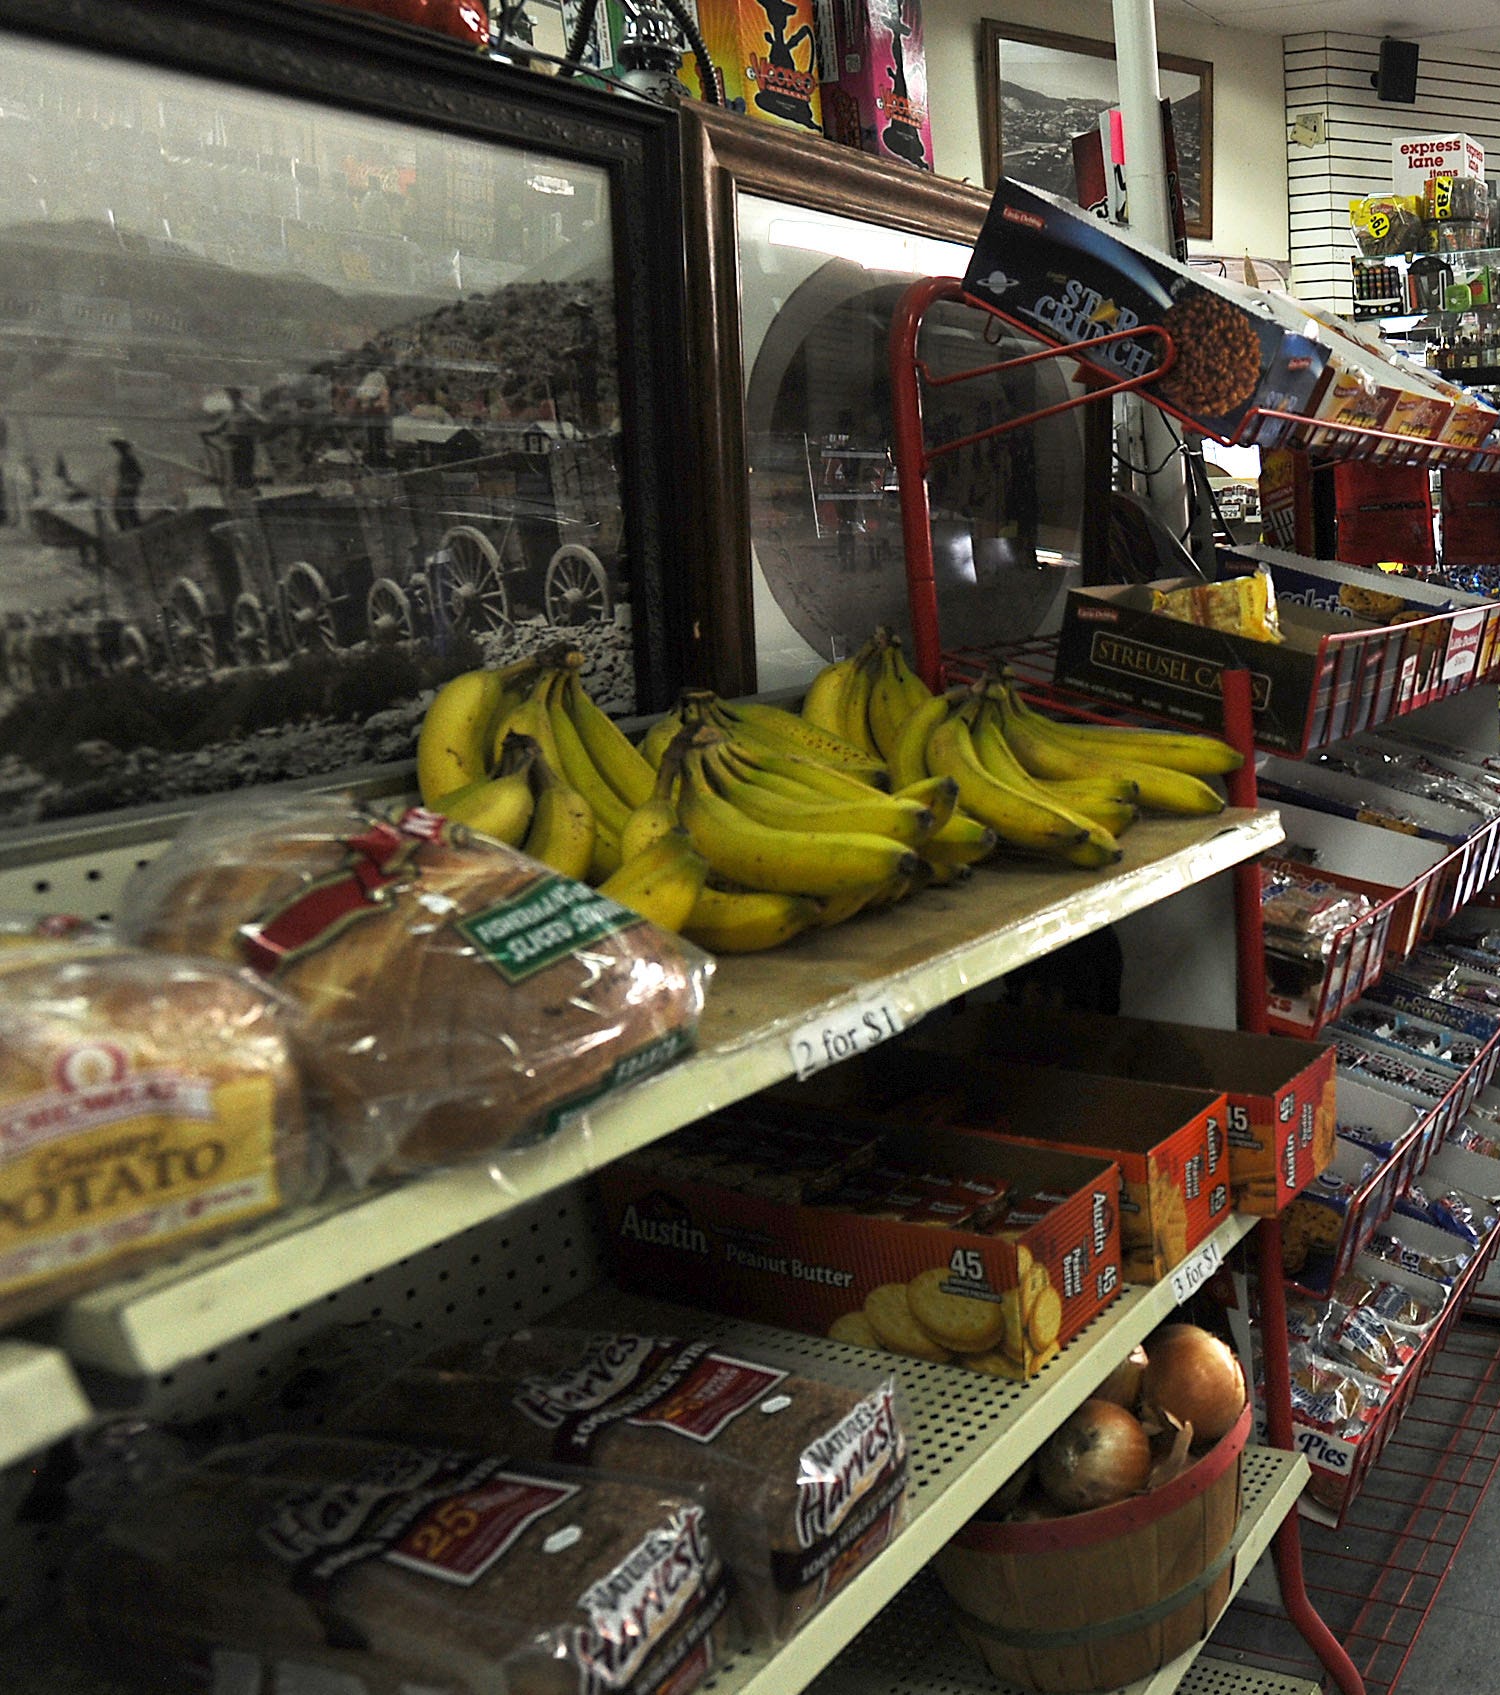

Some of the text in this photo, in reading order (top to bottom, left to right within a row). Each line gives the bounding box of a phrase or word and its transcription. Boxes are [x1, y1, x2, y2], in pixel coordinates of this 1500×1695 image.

[1400, 139, 1461, 156] express
[1408, 156, 1444, 169] lane
[1429, 168, 1458, 178] items
[1099, 639, 1187, 687] STREUSEL
[1195, 669, 1263, 700] CAS
[797, 1006, 896, 1073] 2 for $1
[1206, 1117, 1218, 1176] Austin
[1285, 1133, 1297, 1189] Austin
[1, 1141, 226, 1229] OTATO
[620, 1204, 709, 1256] Austin
[725, 1242, 787, 1276] Peanut
[791, 1262, 854, 1289] Butter
[950, 1248, 984, 1281] 45
[1092, 1192, 1108, 1257] Austin
[1101, 1264, 1118, 1293] 45
[1173, 1277, 1184, 1300] 3
[1184, 1266, 1204, 1289] for
[1298, 1433, 1348, 1467] Pies
[410, 1502, 480, 1559] 25
